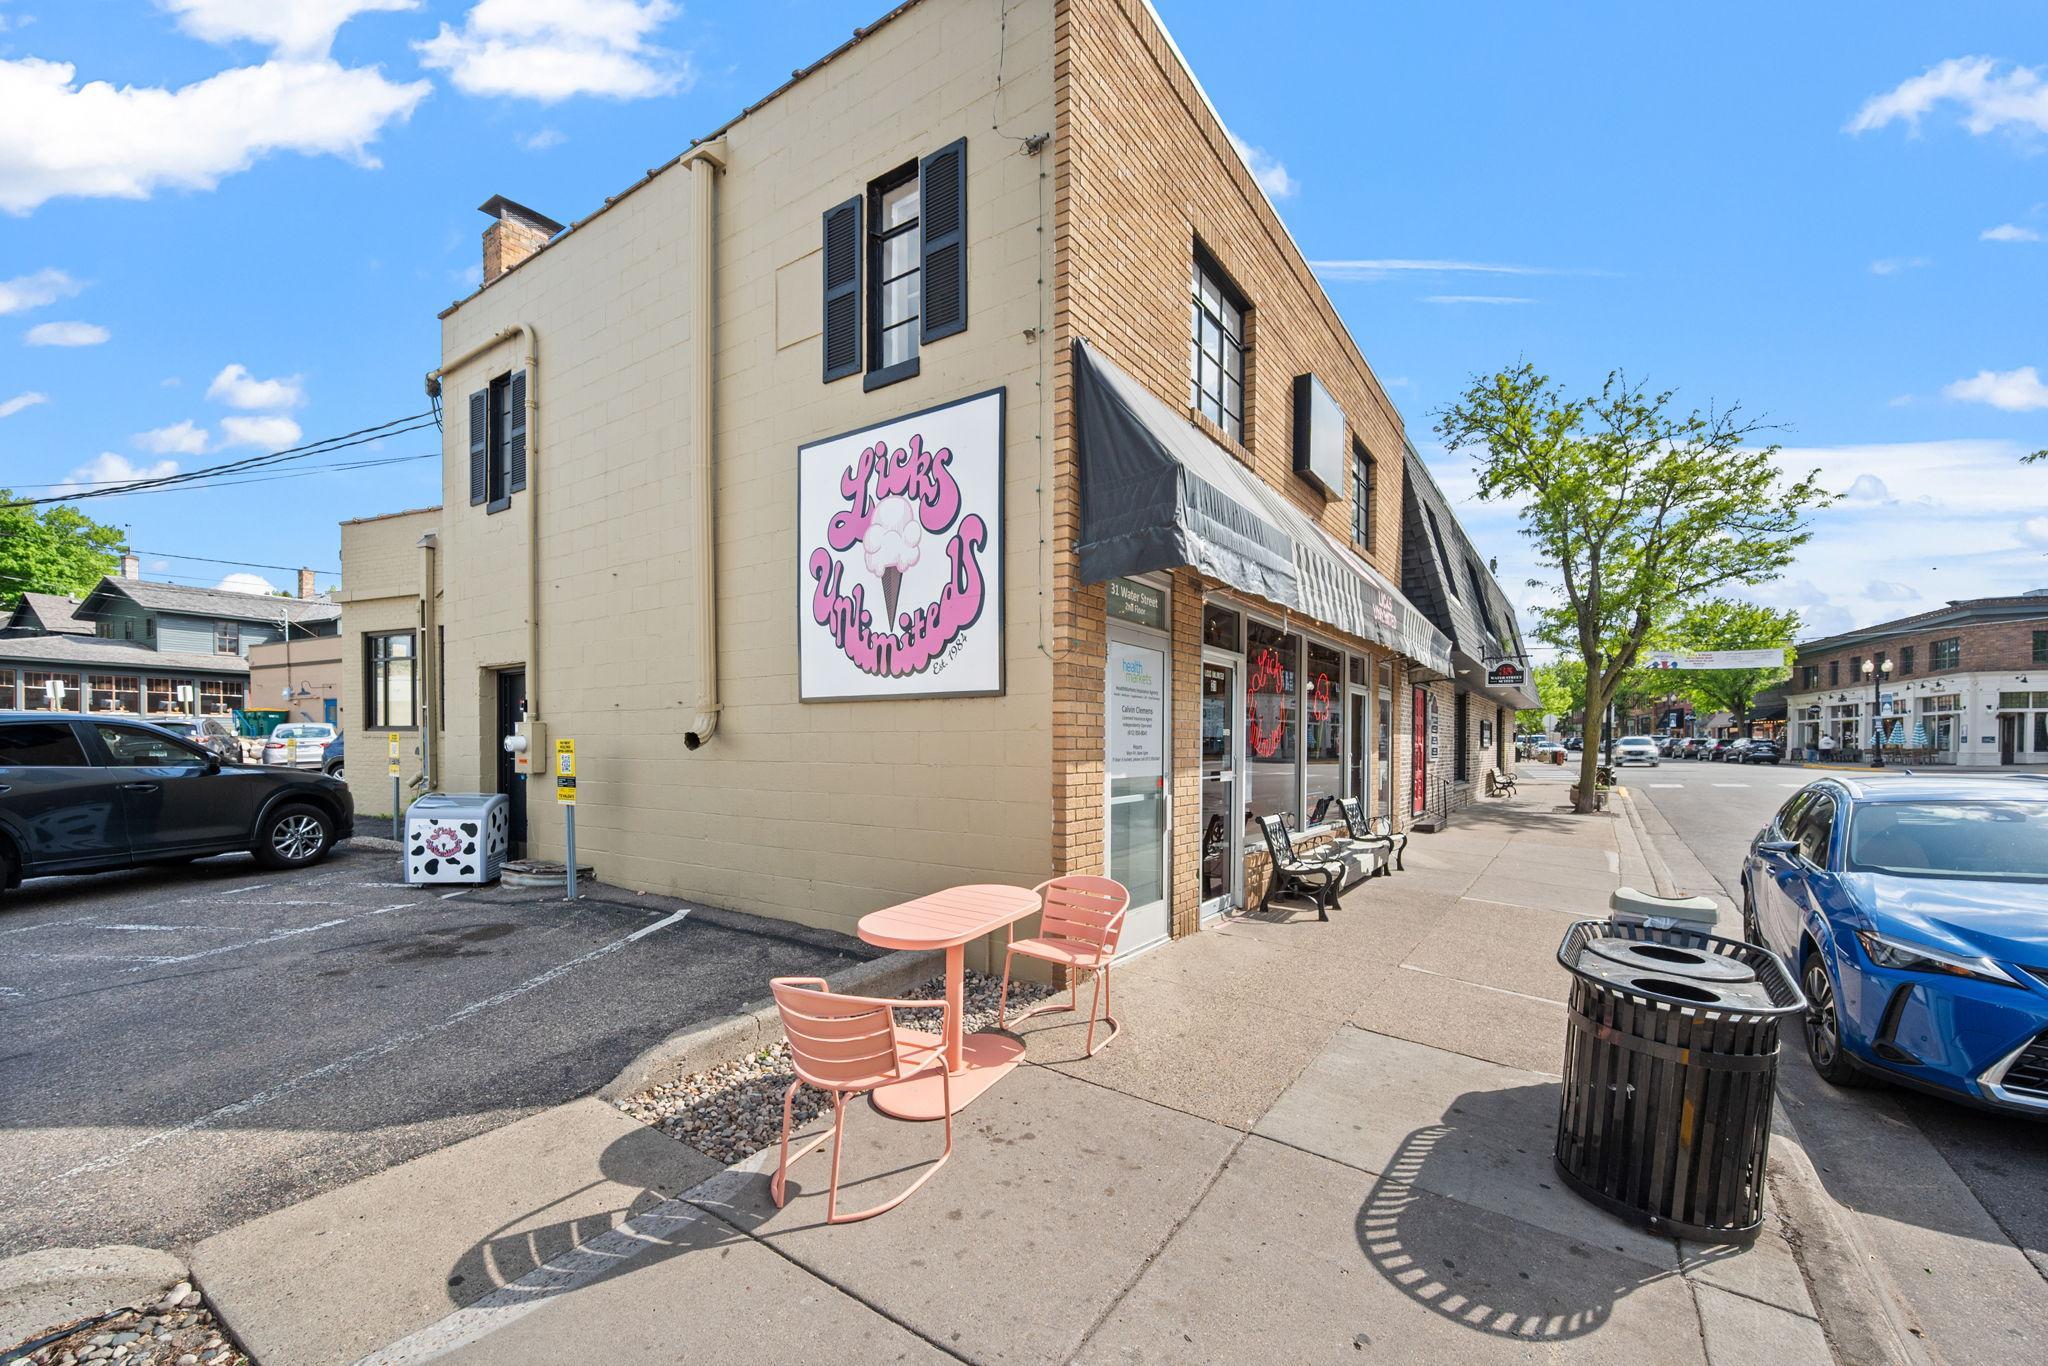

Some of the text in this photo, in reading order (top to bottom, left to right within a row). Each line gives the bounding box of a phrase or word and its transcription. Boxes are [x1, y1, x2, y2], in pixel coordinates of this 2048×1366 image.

[828, 433, 962, 552] Licks
[809, 513, 988, 679] Unlimited
[1110, 582, 1159, 609] 31 Water Street
[1134, 604, 1146, 615] Floor
[932, 632, 969, 676] Est. 1984
[1122, 658, 1143, 674] health
[1251, 648, 1285, 695] Licks
[1121, 704, 1135, 713] Calvin
